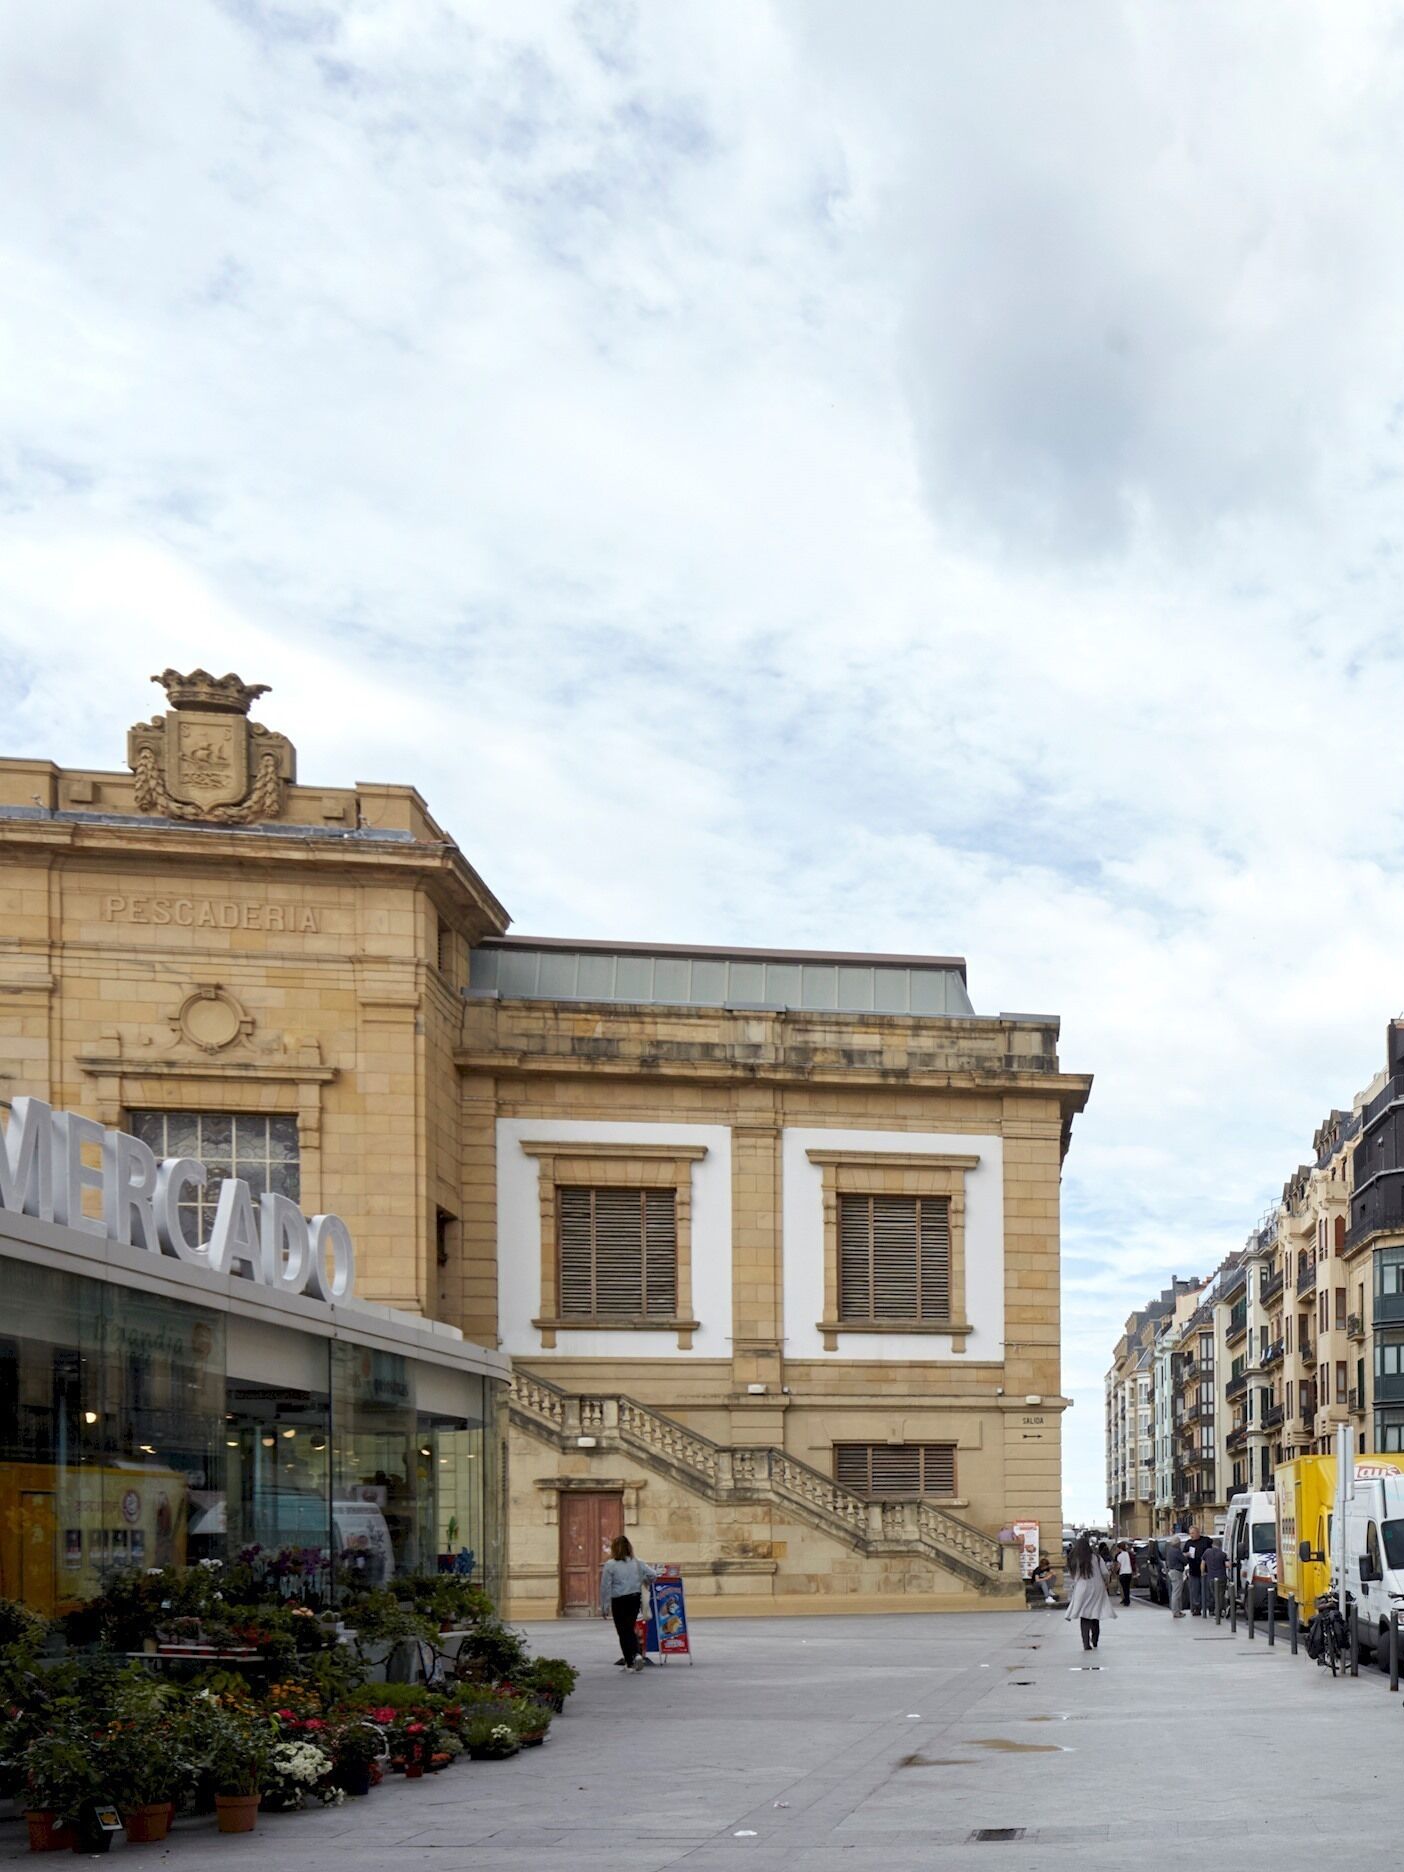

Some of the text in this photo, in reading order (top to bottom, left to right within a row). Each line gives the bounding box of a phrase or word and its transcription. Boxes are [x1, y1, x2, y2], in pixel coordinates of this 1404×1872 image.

[104, 896, 320, 934] PESCADERIA
[0, 1096, 355, 1308] MERCADO
[1022, 1416, 1044, 1425] SALIDA
